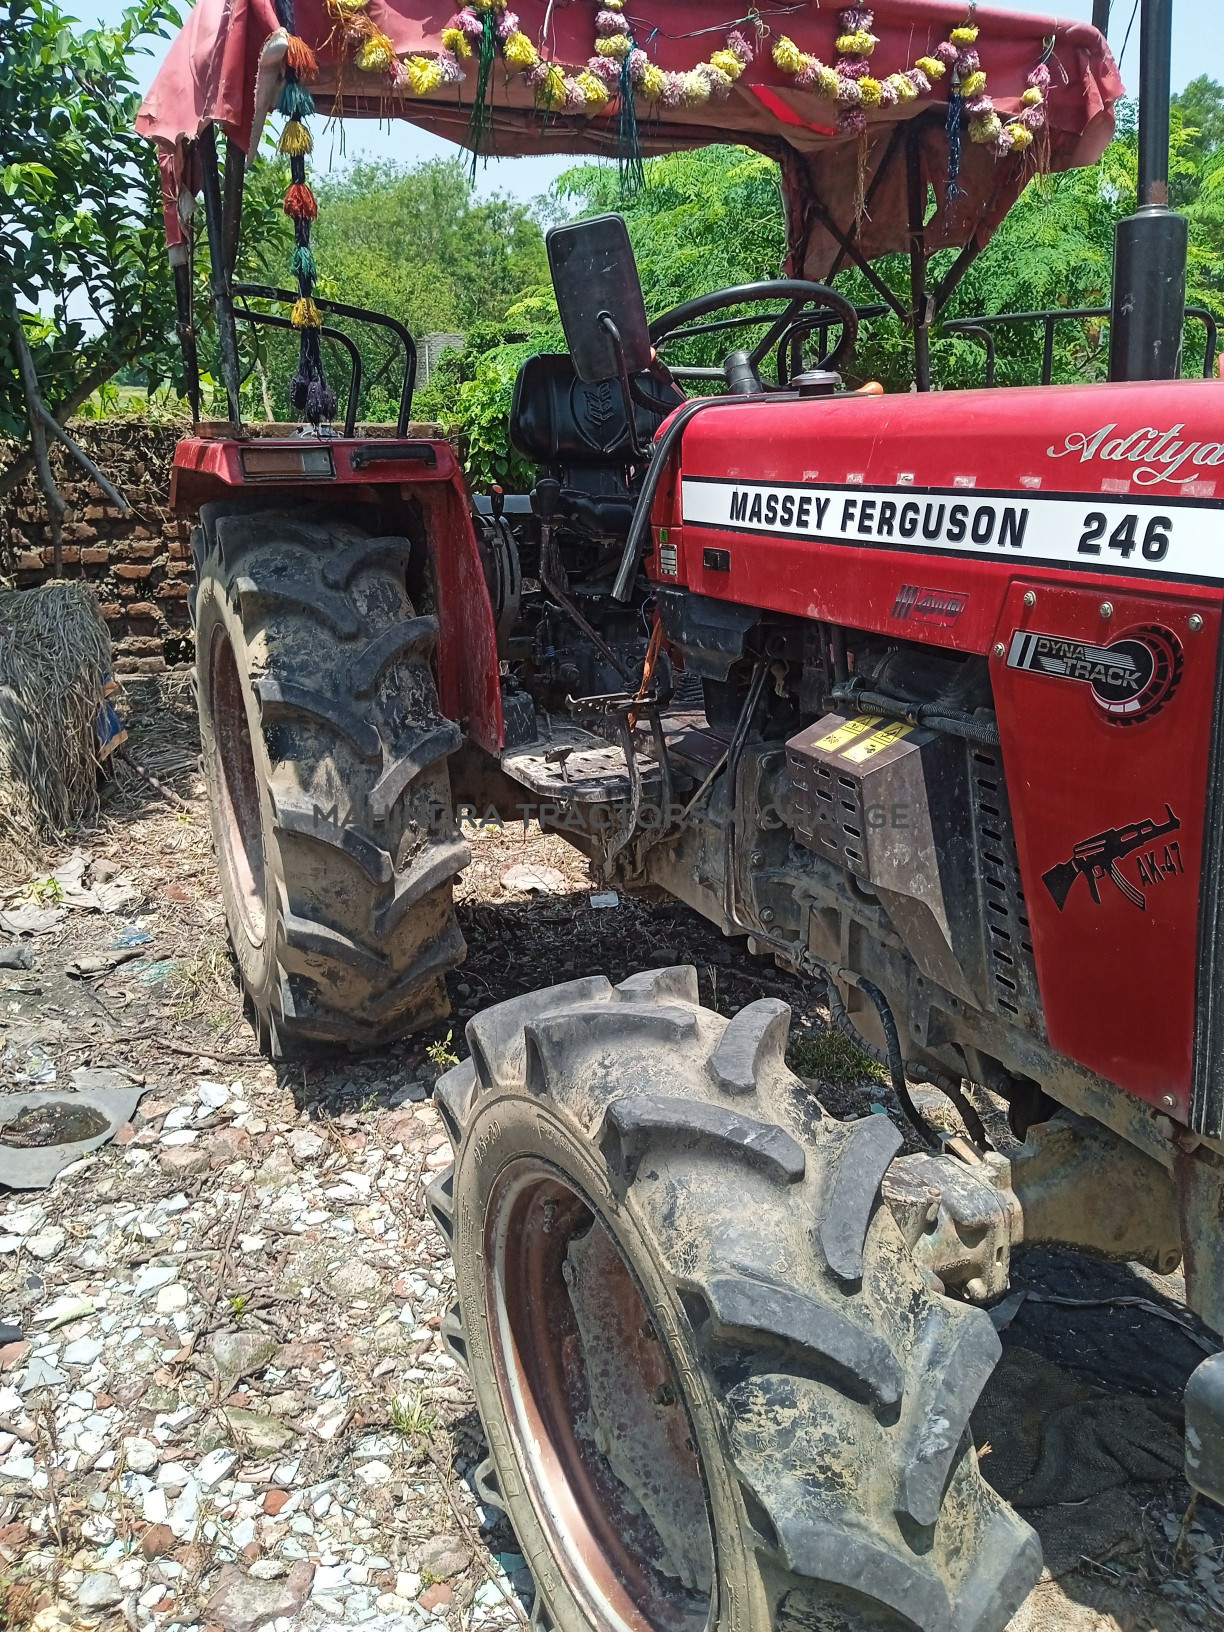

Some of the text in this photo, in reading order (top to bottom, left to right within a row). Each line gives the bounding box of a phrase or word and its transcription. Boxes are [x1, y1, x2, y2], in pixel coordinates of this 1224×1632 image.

[1046, 423, 1224, 486] Aditya
[729, 490, 1174, 563] MASSEY FERGUSON 246
[1037, 639, 1085, 660] DYNA
[1062, 657, 1142, 690] TRACK
[1136, 840, 1184, 888] AK-47
